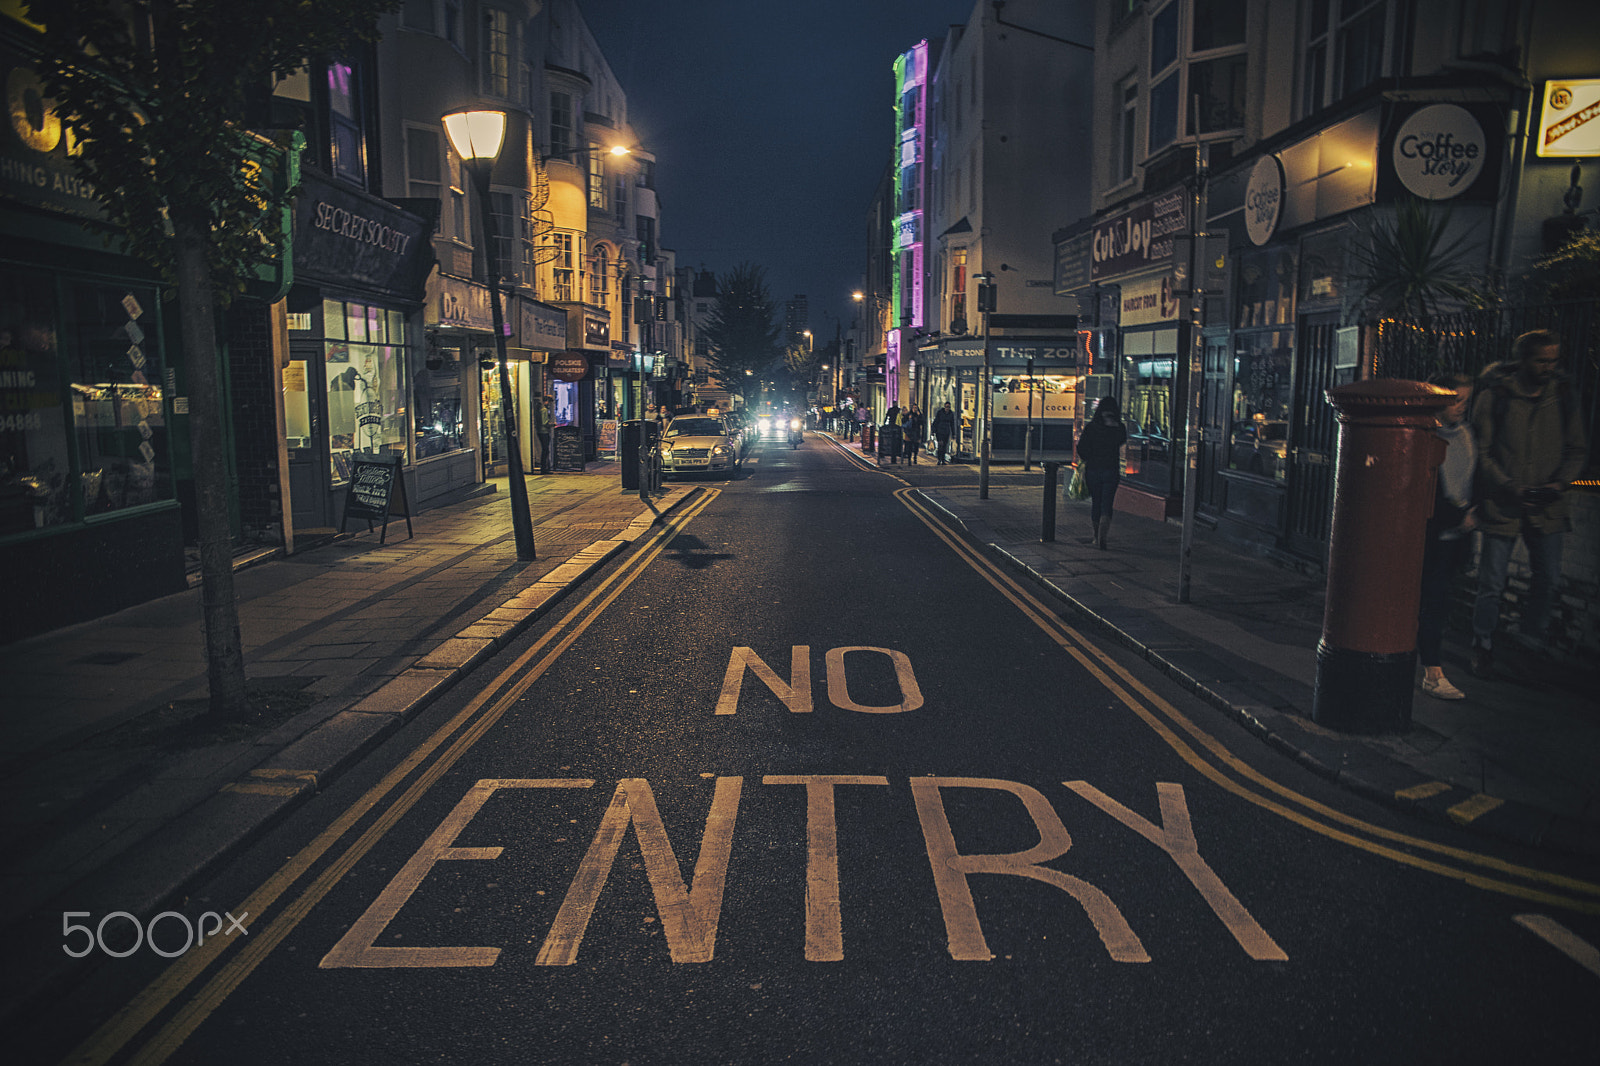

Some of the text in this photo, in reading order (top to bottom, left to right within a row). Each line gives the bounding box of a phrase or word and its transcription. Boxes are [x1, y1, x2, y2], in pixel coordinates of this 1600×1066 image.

[1400, 133, 1479, 160] Coffee
[1093, 227, 1115, 262] Cut
[1124, 217, 1151, 259] Joy
[1043, 347, 1084, 359] ZON
[715, 645, 924, 716] NO
[318, 774, 1290, 970] ENTRY
